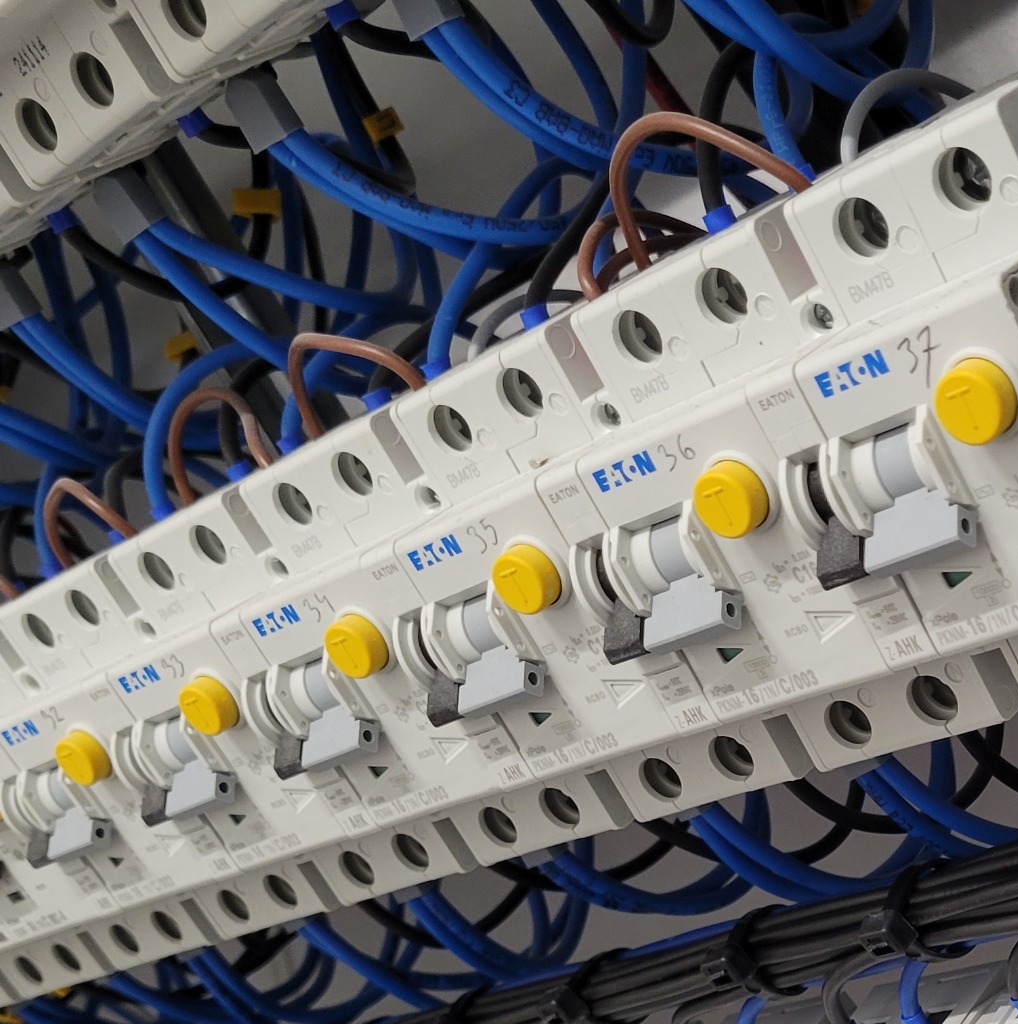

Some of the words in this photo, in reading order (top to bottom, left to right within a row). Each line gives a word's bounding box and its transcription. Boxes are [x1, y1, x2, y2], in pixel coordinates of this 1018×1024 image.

[13, 35, 50, 77] 241114
[848, 271, 895, 305] BM47B
[814, 349, 891, 398] EATON
[897, 325, 942, 389] 37
[629, 368, 671, 405] BM47B
[758, 388, 796, 412] EATON
[656, 433, 697, 473] 36
[592, 450, 658, 493] EATON
[549, 484, 580, 504] EATON
[407, 534, 464, 571] EATON
[466, 518, 499, 555] 35
[372, 563, 399, 582] EATON
[252, 603, 302, 638] EATON
[302, 592, 336, 624] 34
[220, 629, 245, 647] EATON
[784, 624, 810, 640] RCBO
[885, 633, 924, 662] Z-AHK
[118, 664, 162, 694] EATON
[1, 719, 40, 746] EATON
